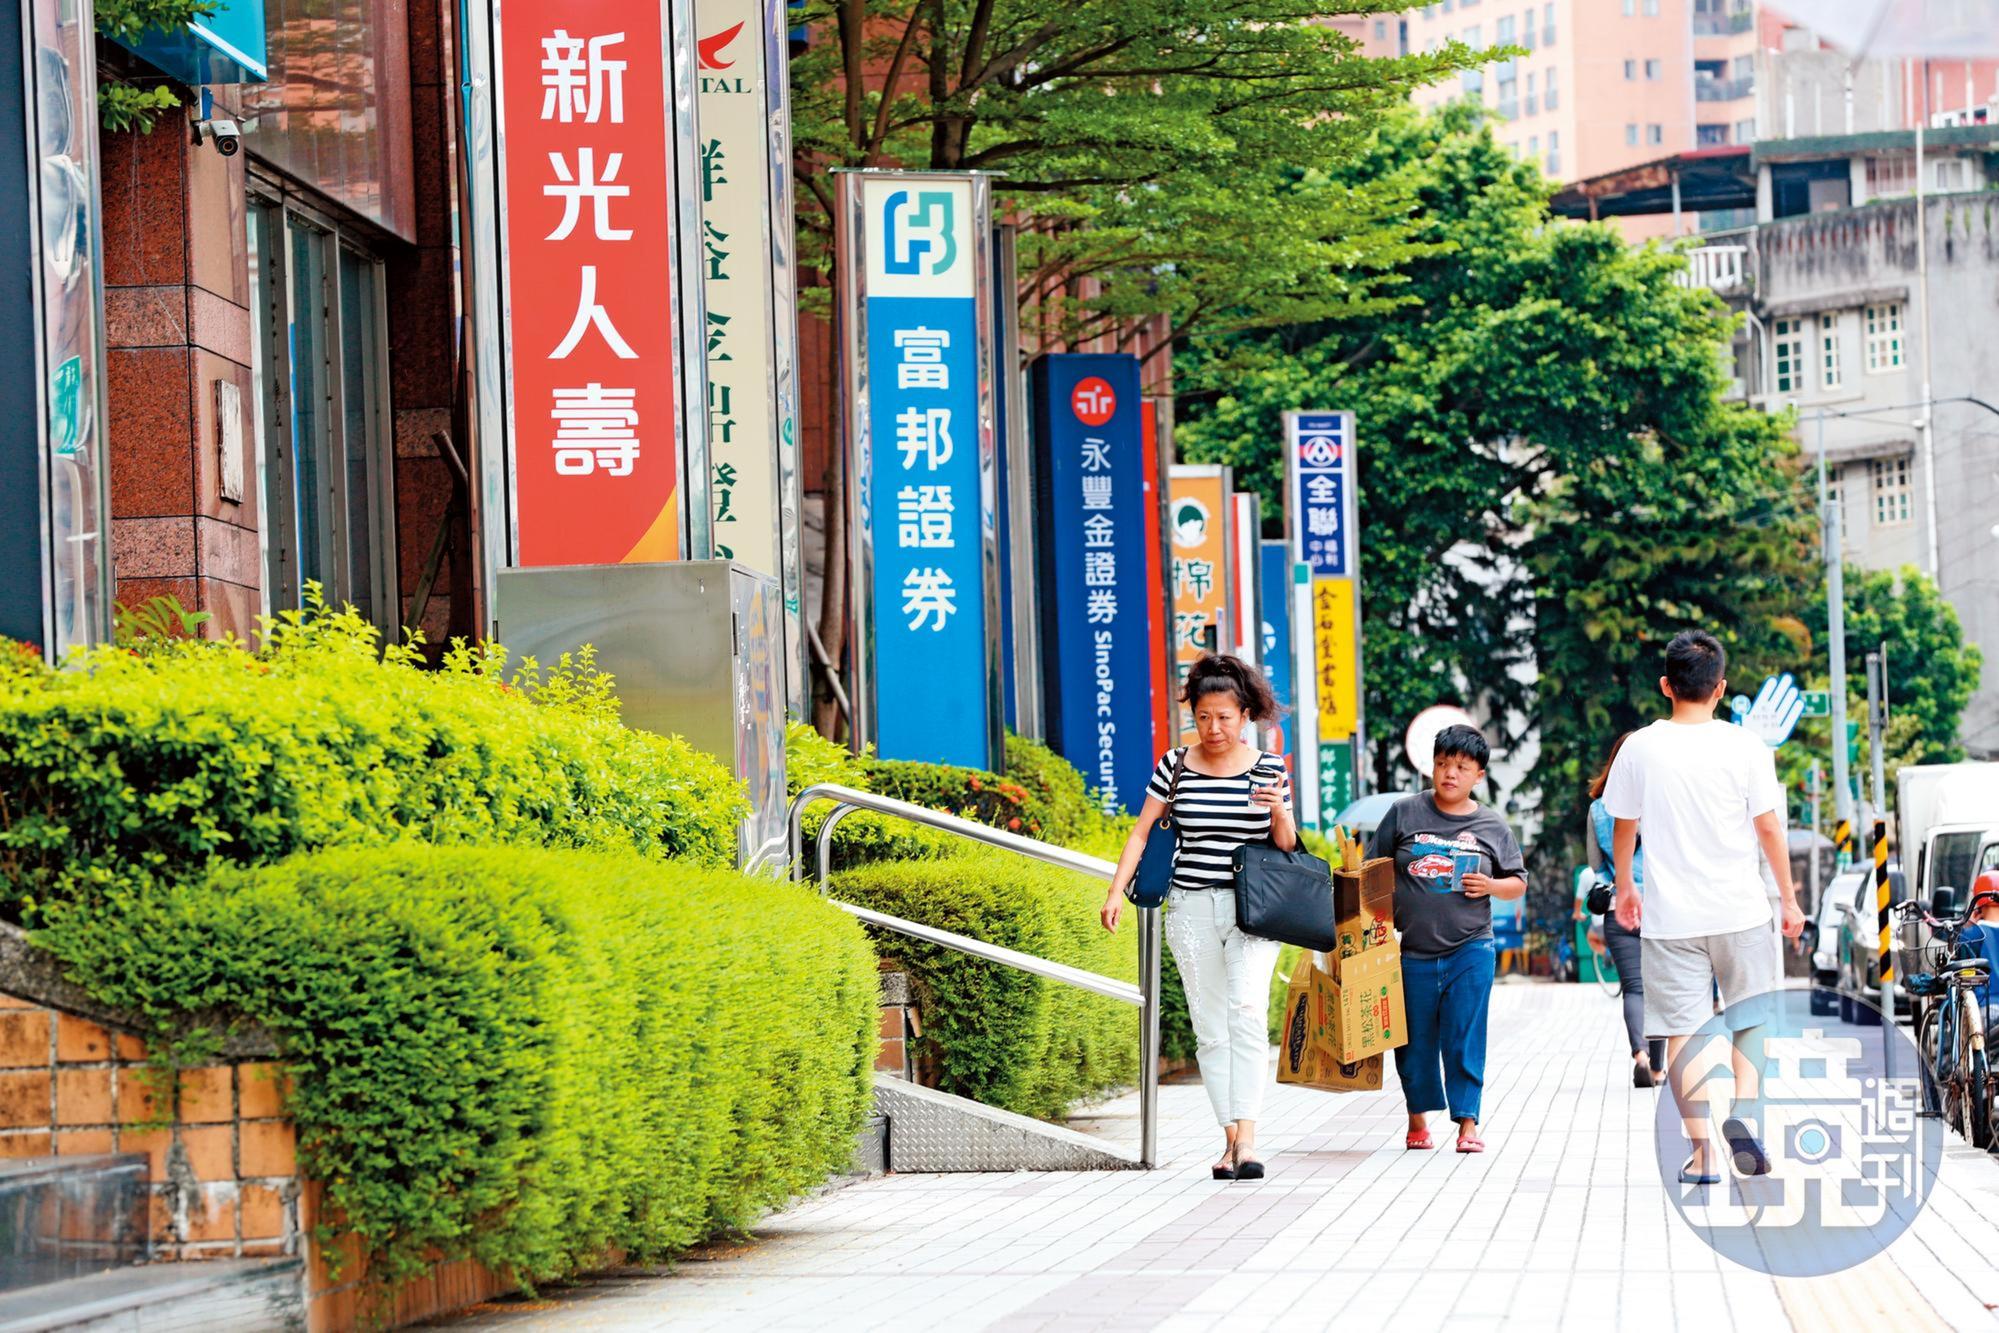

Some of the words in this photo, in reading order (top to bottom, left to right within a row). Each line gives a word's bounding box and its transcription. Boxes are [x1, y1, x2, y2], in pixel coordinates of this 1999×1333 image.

[540, 29, 640, 477] 新光人壽
[893, 325, 957, 633] 富邦證券
[1080, 437, 1118, 625] 永豐金證券
[1095, 629, 1114, 717] SinoPac
